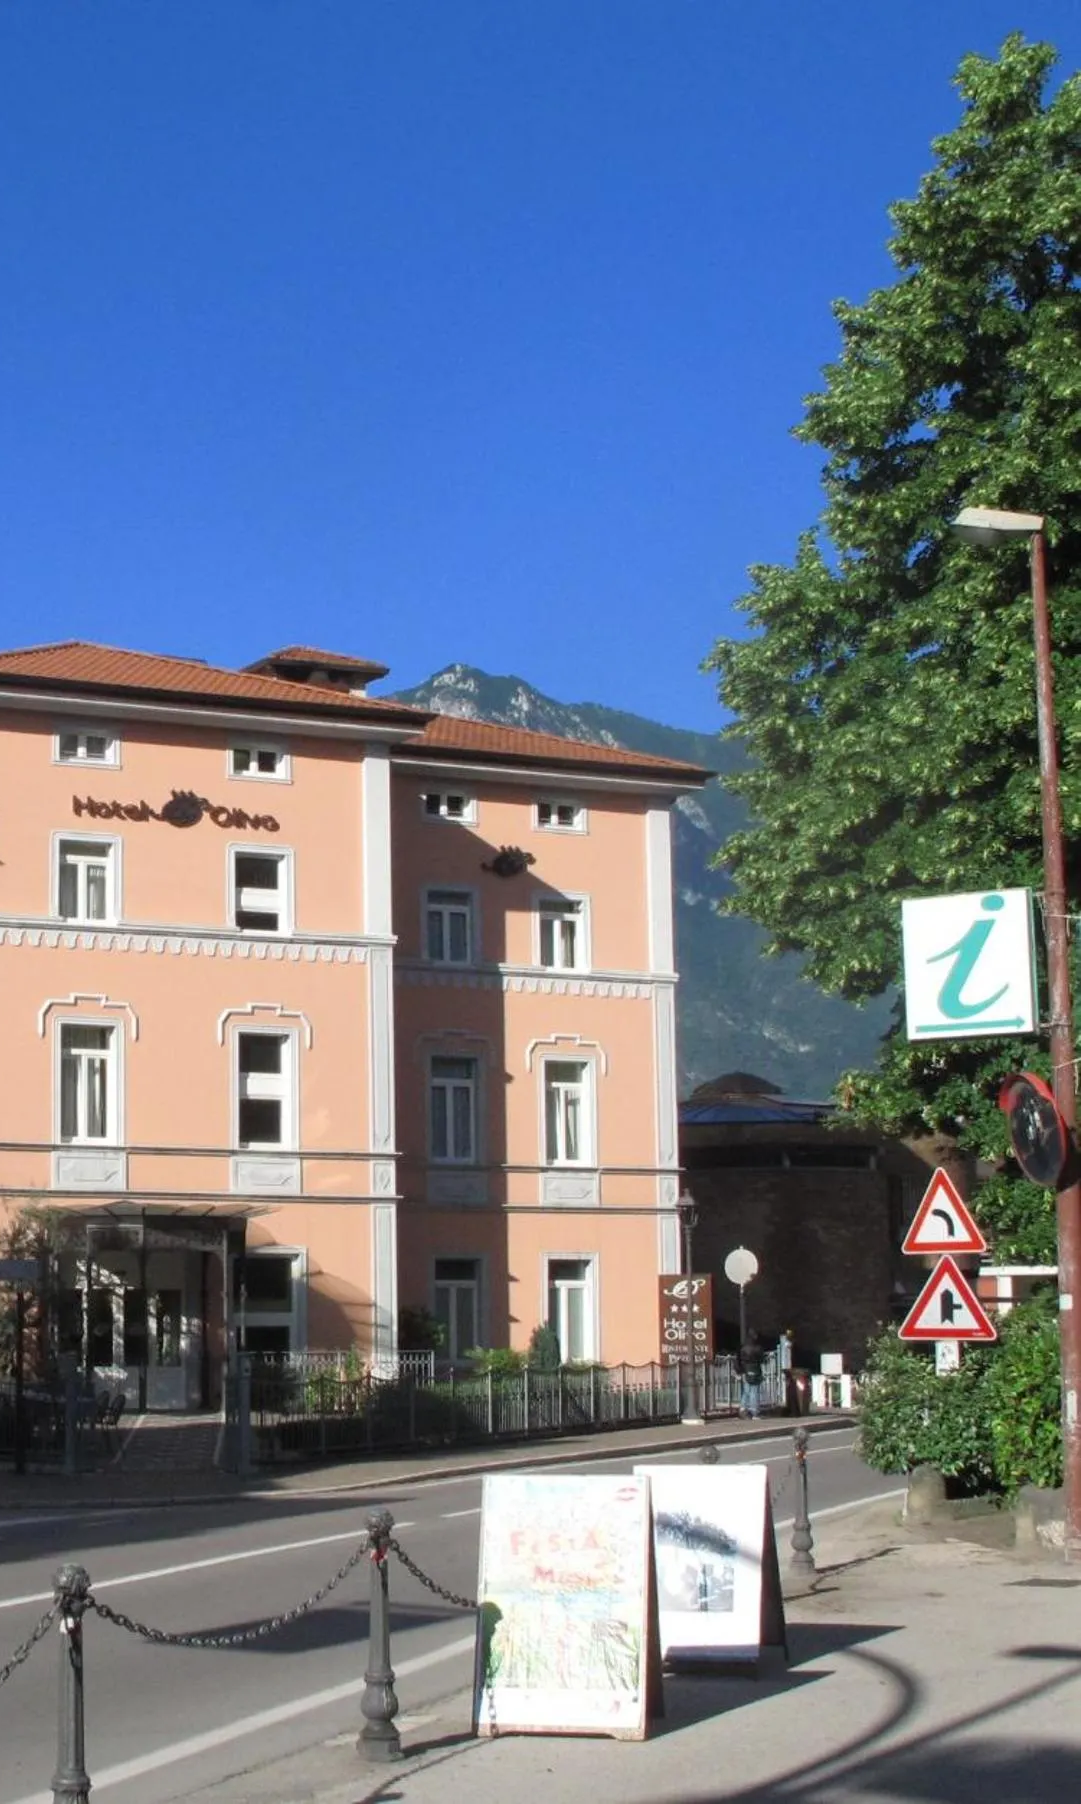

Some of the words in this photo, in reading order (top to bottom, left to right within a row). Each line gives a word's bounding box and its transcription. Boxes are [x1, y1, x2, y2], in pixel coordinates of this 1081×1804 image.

[72, 794, 152, 823] Hotel
[926, 894, 1010, 1020] i
[663, 1317, 708, 1329] Hoel
